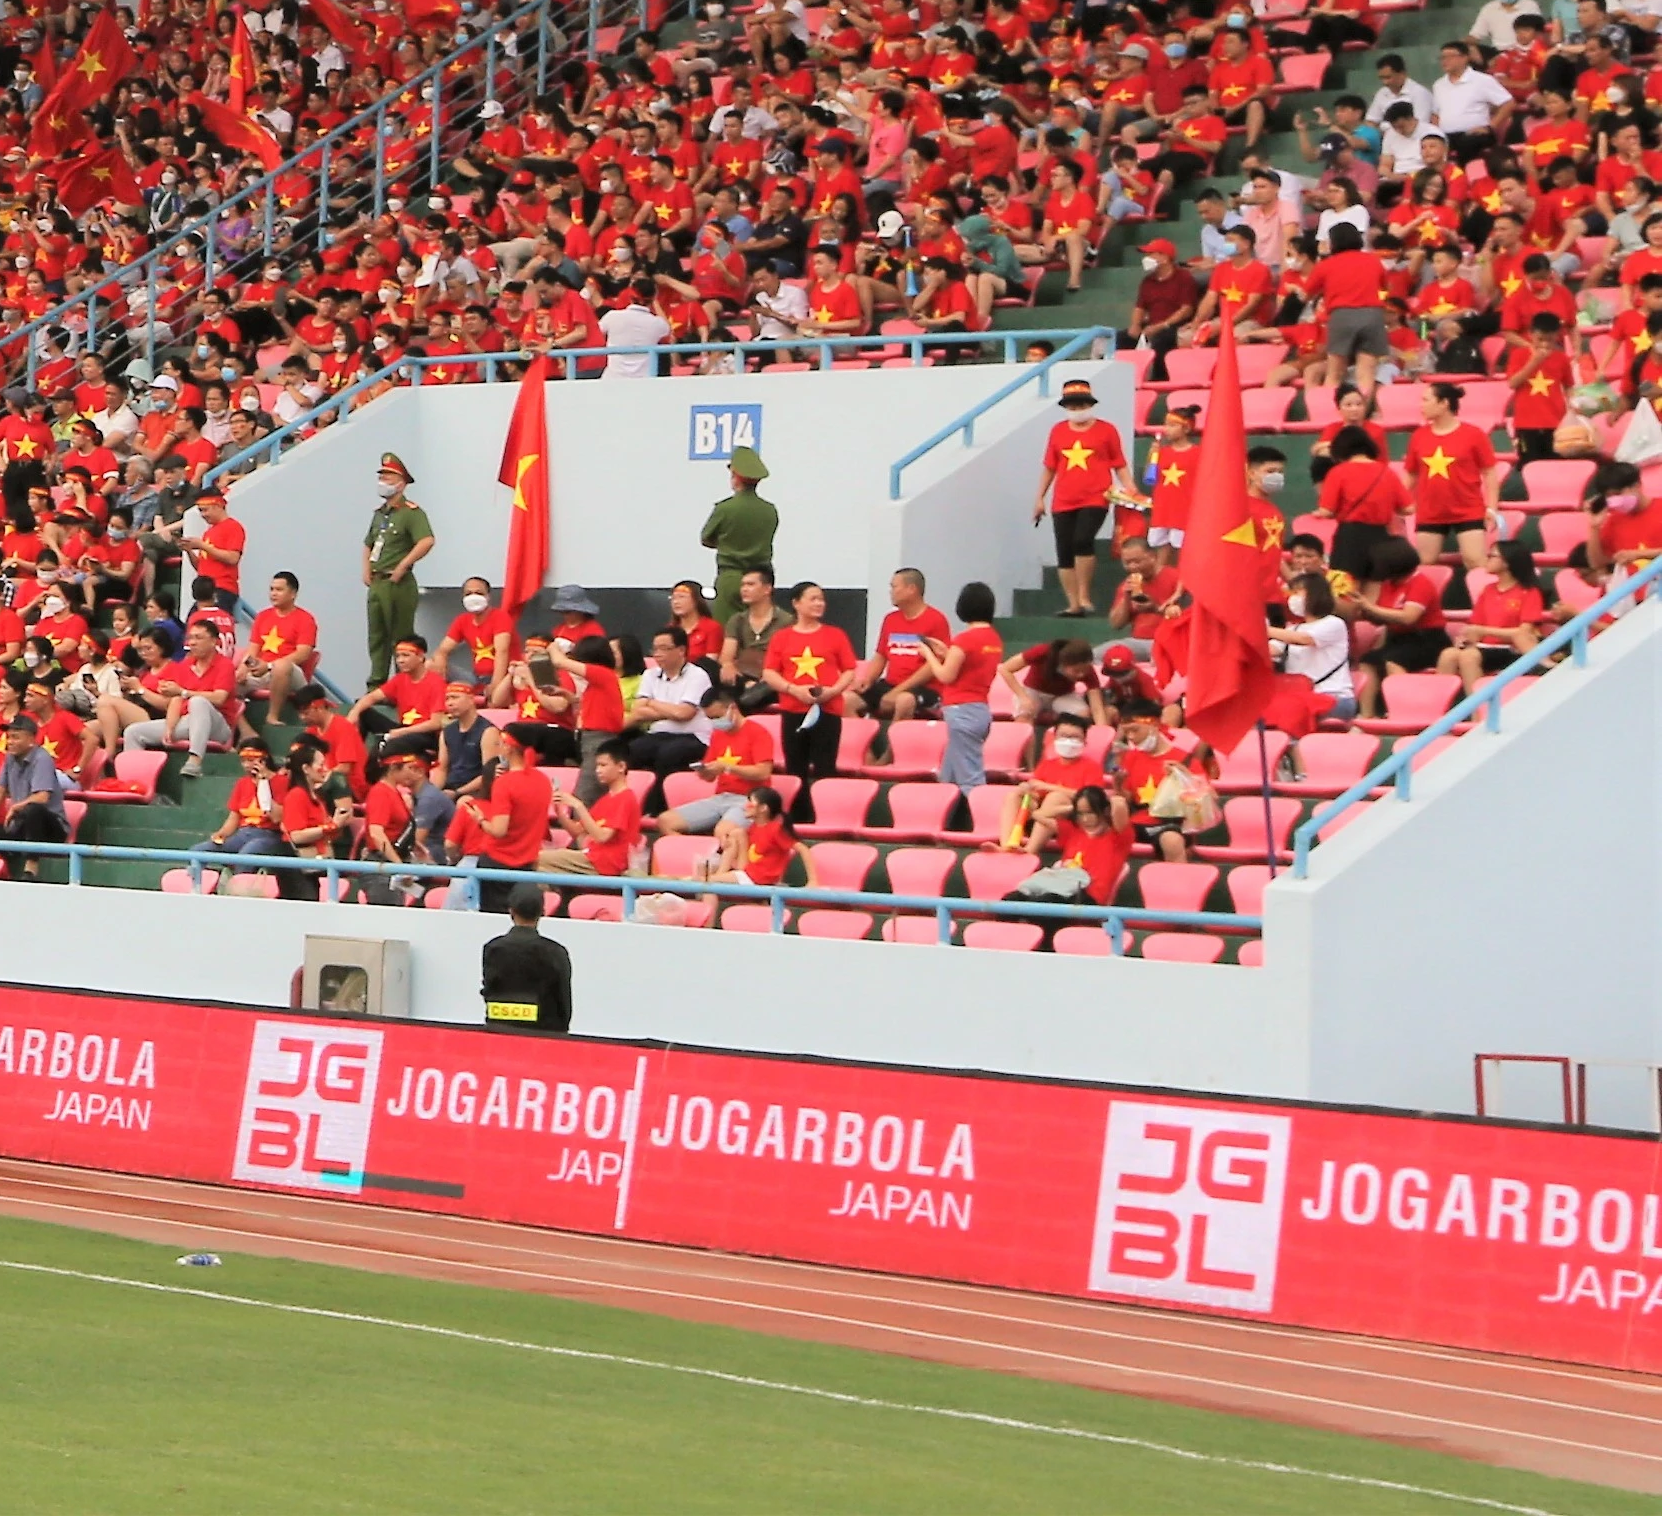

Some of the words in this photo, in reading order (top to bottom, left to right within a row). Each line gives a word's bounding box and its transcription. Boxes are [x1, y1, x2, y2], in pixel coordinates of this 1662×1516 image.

[694, 412, 755, 455] B14
[43, 1089, 152, 1131] JAPAN
[650, 1094, 975, 1181] JOGARBOLA
[828, 1180, 973, 1231] JAPAN
